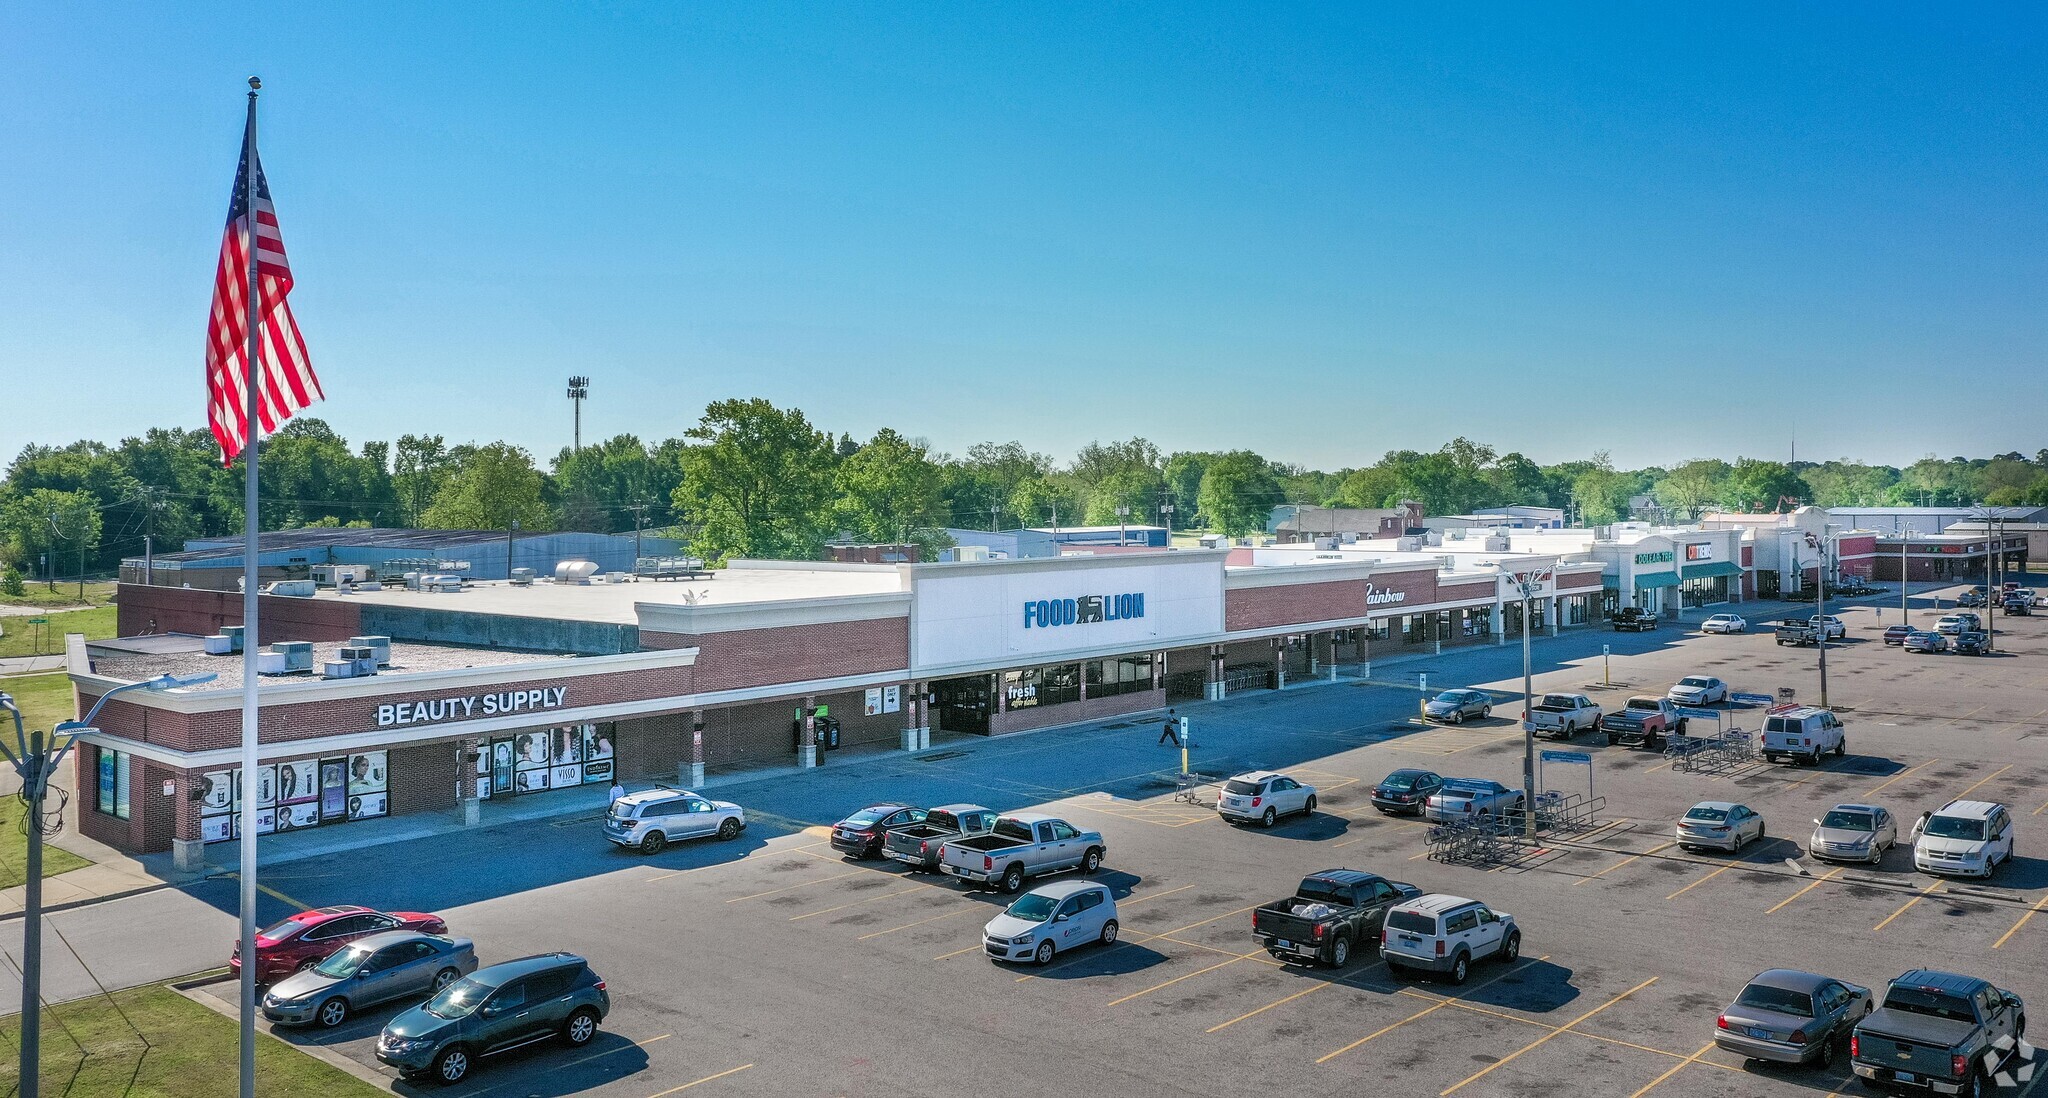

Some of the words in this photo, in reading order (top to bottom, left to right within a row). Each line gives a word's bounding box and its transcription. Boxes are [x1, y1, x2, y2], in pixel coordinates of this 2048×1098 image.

[1024, 599, 1075, 629] FOOD
[1104, 592, 1145, 621] LION
[378, 696, 476, 726] BEAUTY
[482, 686, 567, 715] SUPPLY
[1008, 683, 1036, 699] fresh
